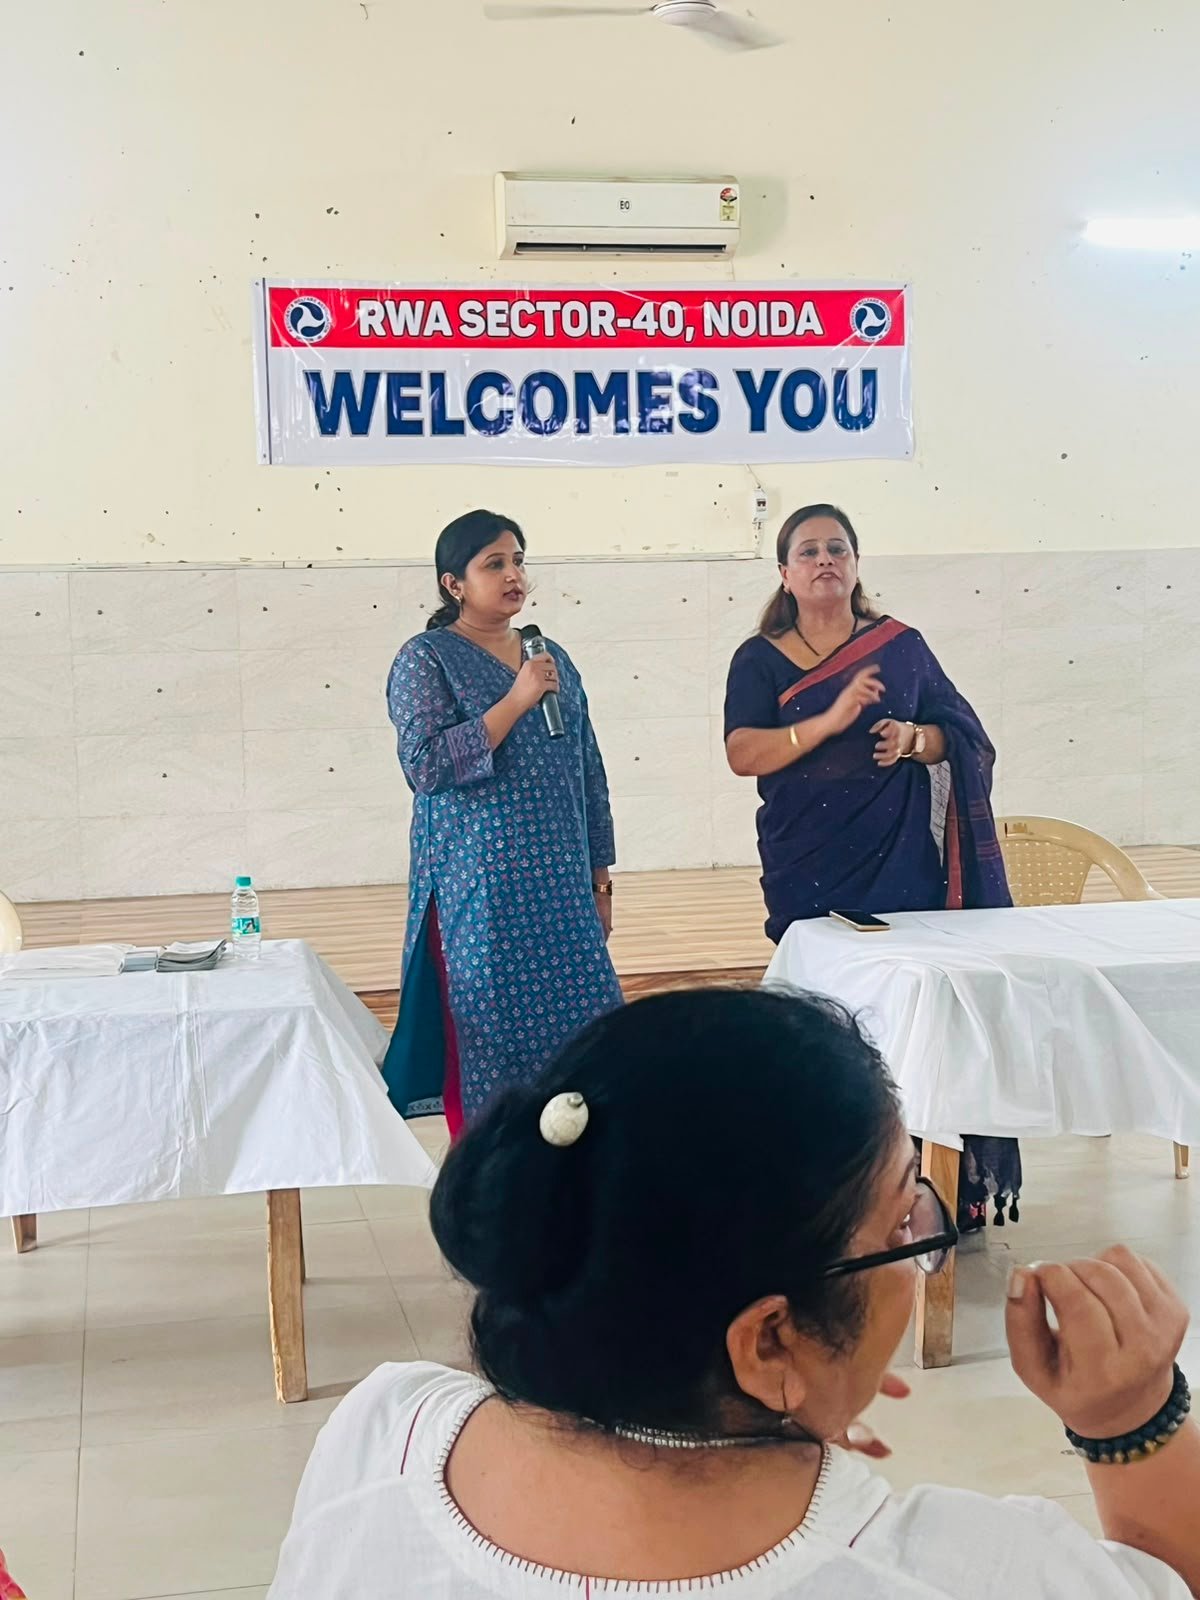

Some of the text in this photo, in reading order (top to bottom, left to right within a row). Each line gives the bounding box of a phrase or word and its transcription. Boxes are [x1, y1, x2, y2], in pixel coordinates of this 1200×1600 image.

[358, 299, 453, 337] RWA
[458, 299, 695, 342] SECTOR-40,
[703, 300, 824, 336] NOIDA
[303, 367, 878, 437] WELCOMES YOU
